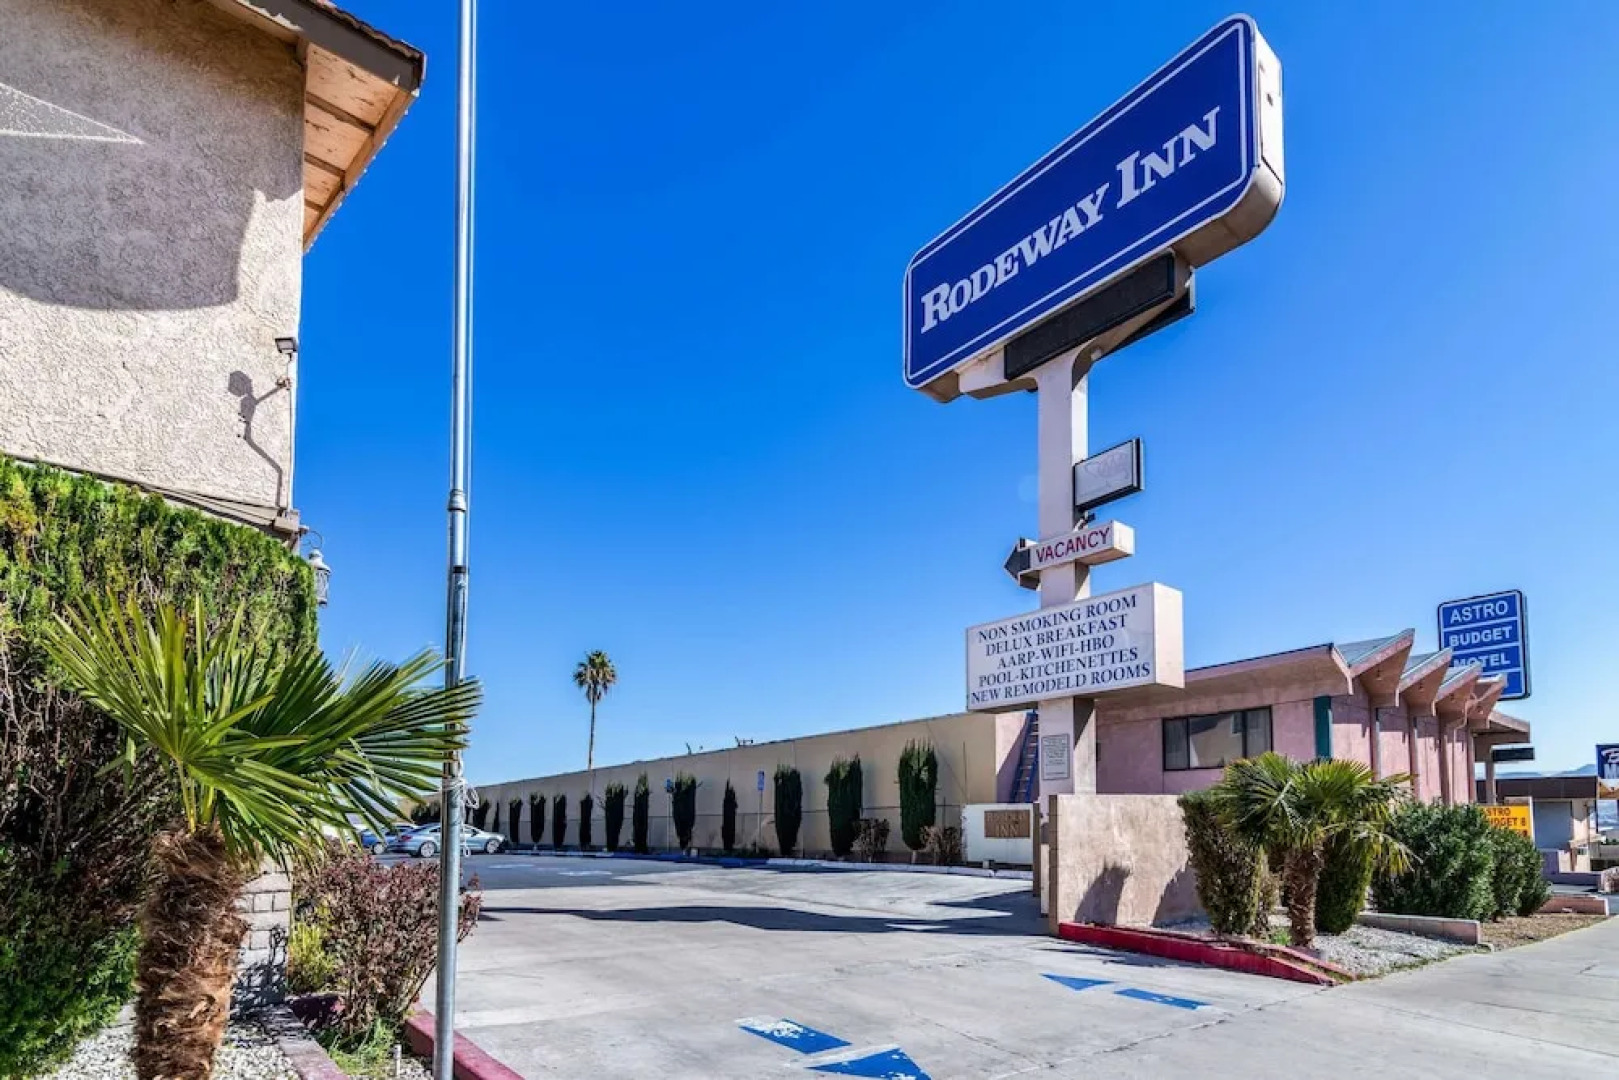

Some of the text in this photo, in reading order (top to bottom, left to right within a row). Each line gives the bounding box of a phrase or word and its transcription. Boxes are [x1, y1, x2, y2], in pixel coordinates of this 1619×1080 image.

[921, 106, 1220, 333] RODEWAY INN
[1036, 528, 1110, 562] VACANCY
[978, 594, 1137, 643] NON SMOKING ROOM
[1450, 600, 1508, 623] ASTRO
[986, 614, 1128, 656] DELUX BREAKFAST
[998, 634, 1114, 669] AARP-WIFI-HBO
[1449, 626, 1513, 647] BUDGET
[979, 647, 1138, 687] POOL-KITCHENETTES
[1453, 652, 1511, 668] MOTEL
[971, 662, 1150, 704] NEW REMODELD ROOMS
